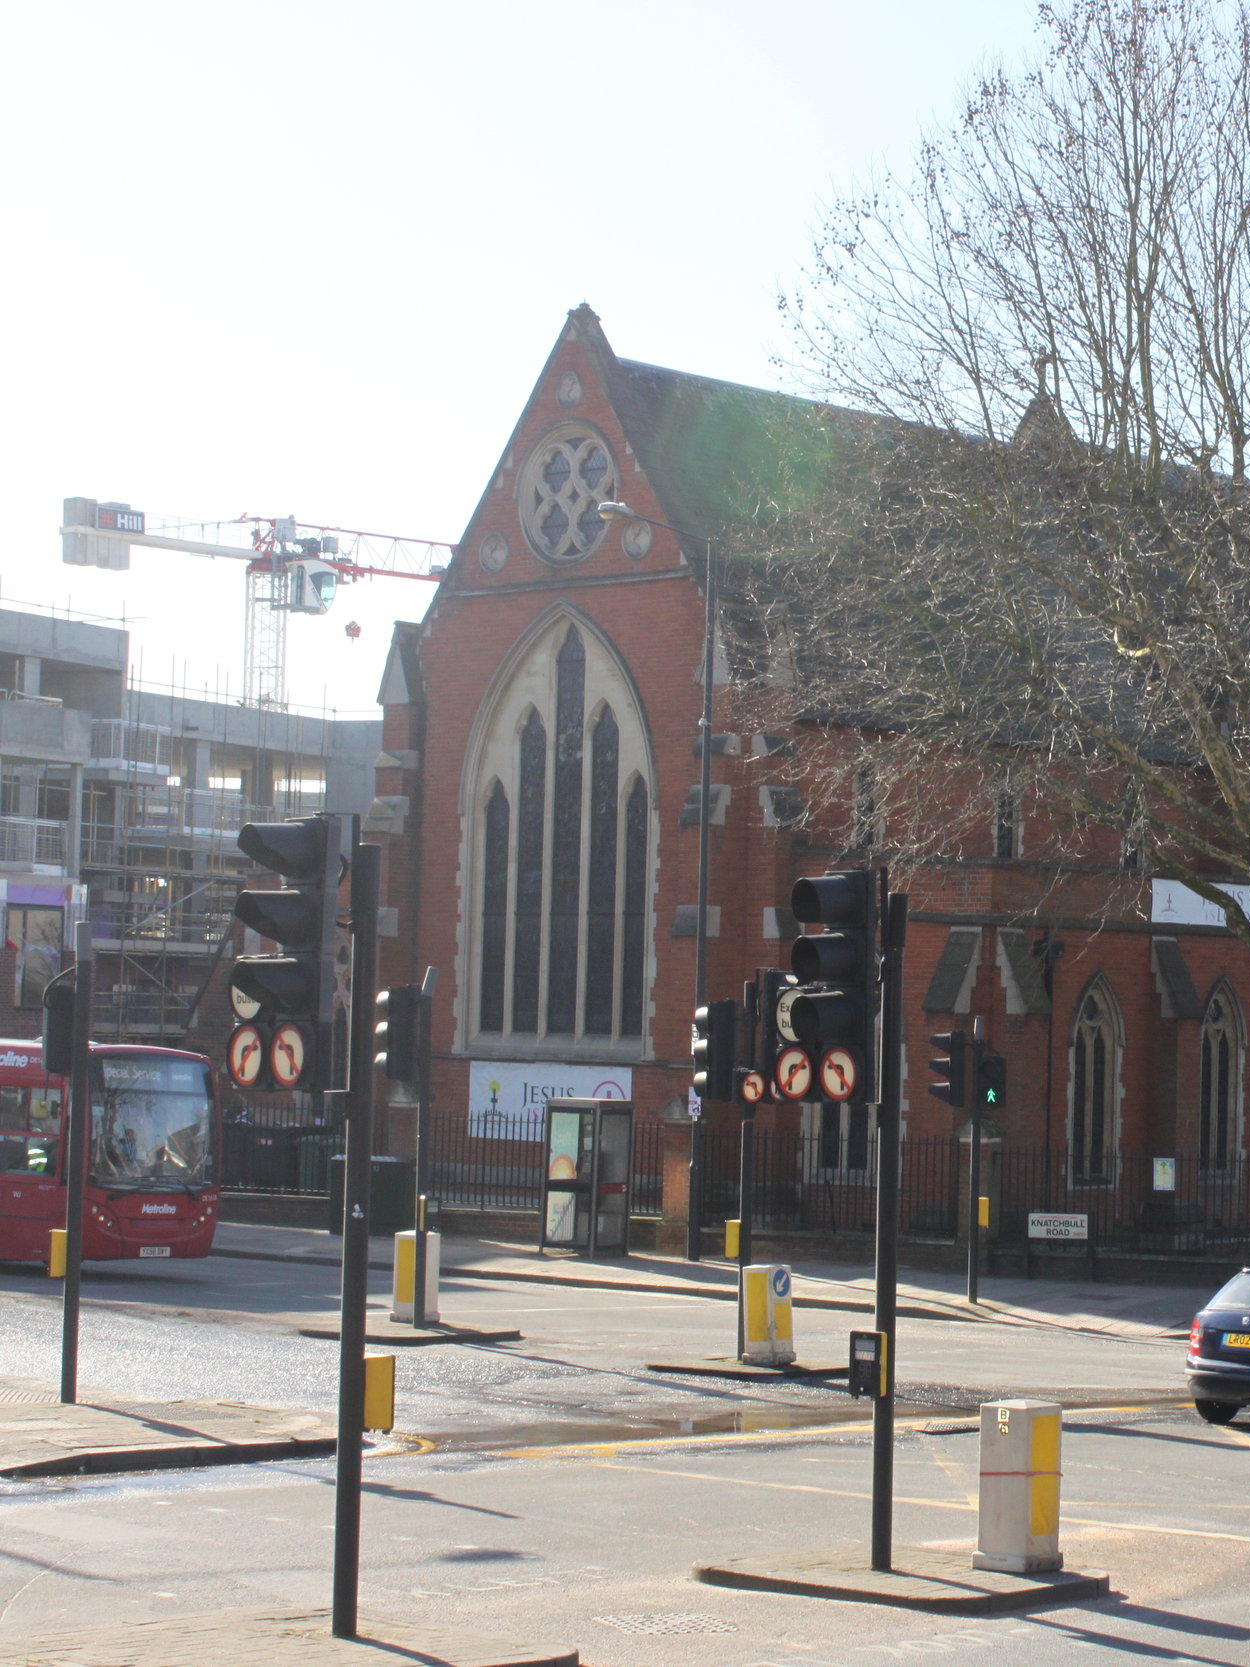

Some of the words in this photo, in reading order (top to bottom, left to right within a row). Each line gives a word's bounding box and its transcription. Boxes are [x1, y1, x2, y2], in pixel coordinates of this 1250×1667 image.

[117, 513, 143, 531] Hill
[132, 1066, 161, 1081] Service
[141, 1203, 177, 1215] Metroline
[1031, 1219, 1085, 1228] KNATCHBULL
[1046, 1228, 1070, 1236] ROAD
[1228, 1334, 1250, 1346] LR02
[1000, 1409, 1007, 1420] B
